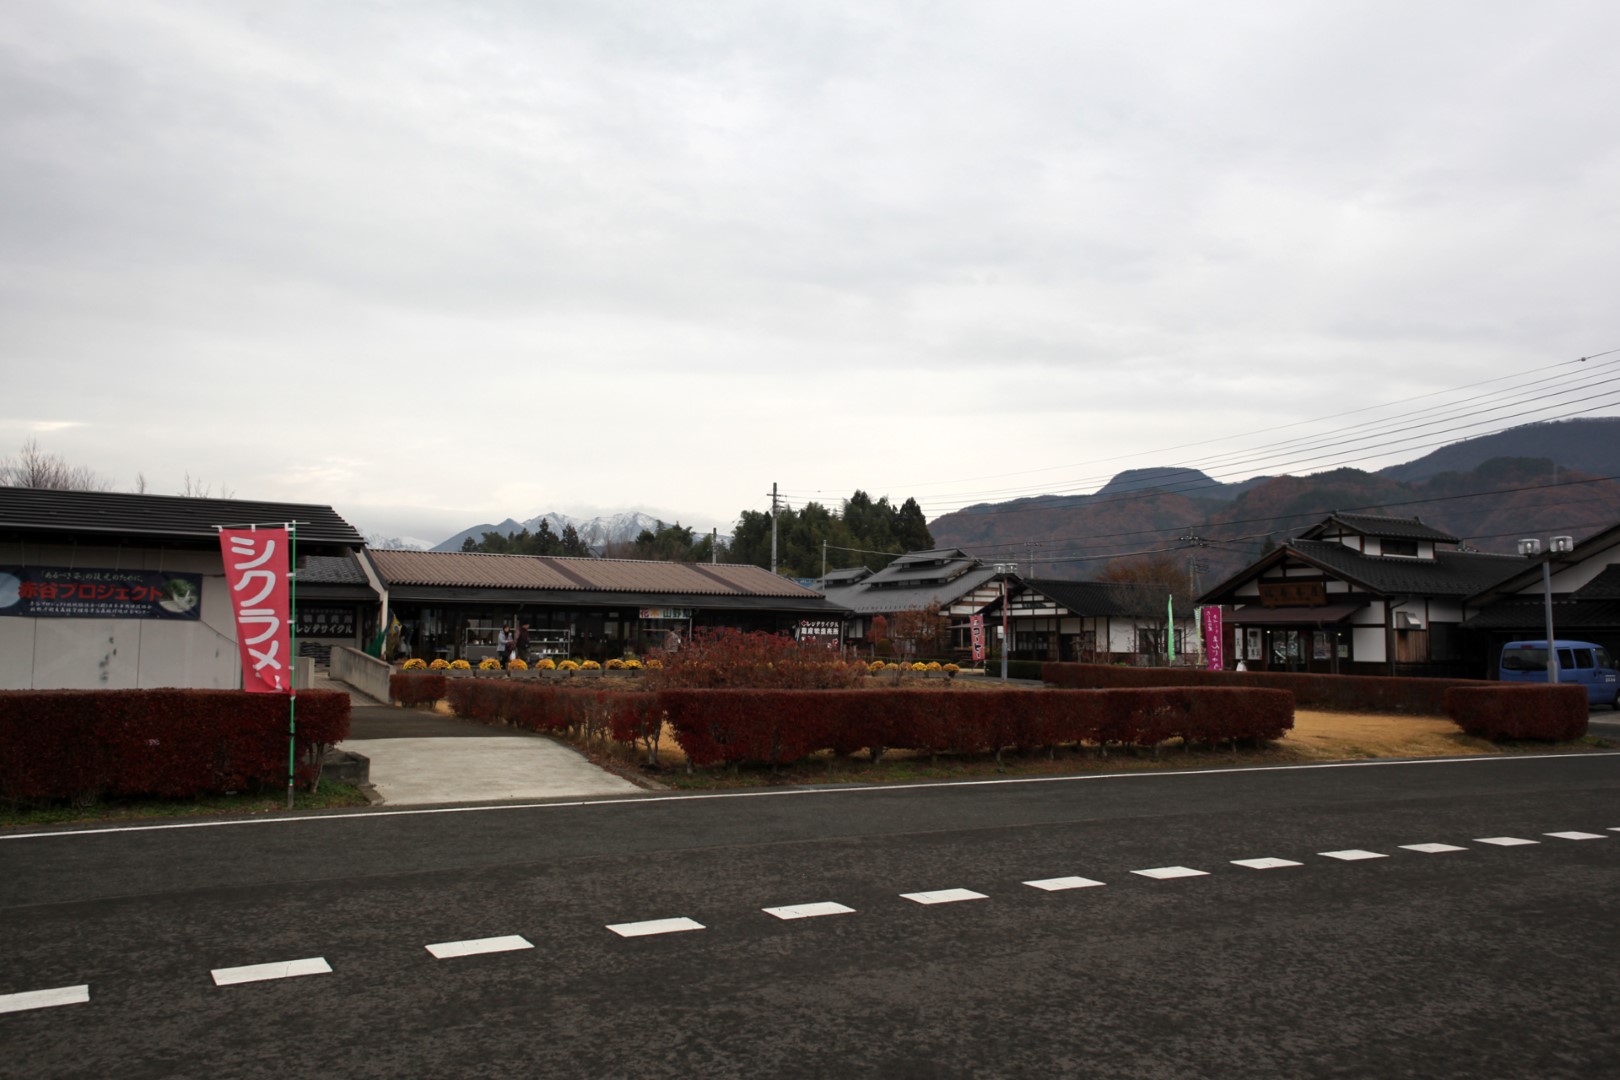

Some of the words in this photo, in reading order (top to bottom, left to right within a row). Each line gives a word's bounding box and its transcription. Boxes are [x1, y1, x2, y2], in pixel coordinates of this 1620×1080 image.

[18, 580, 165, 602] 赤谷プロジェクト
[296, 623, 353, 634] レンタサイクル
